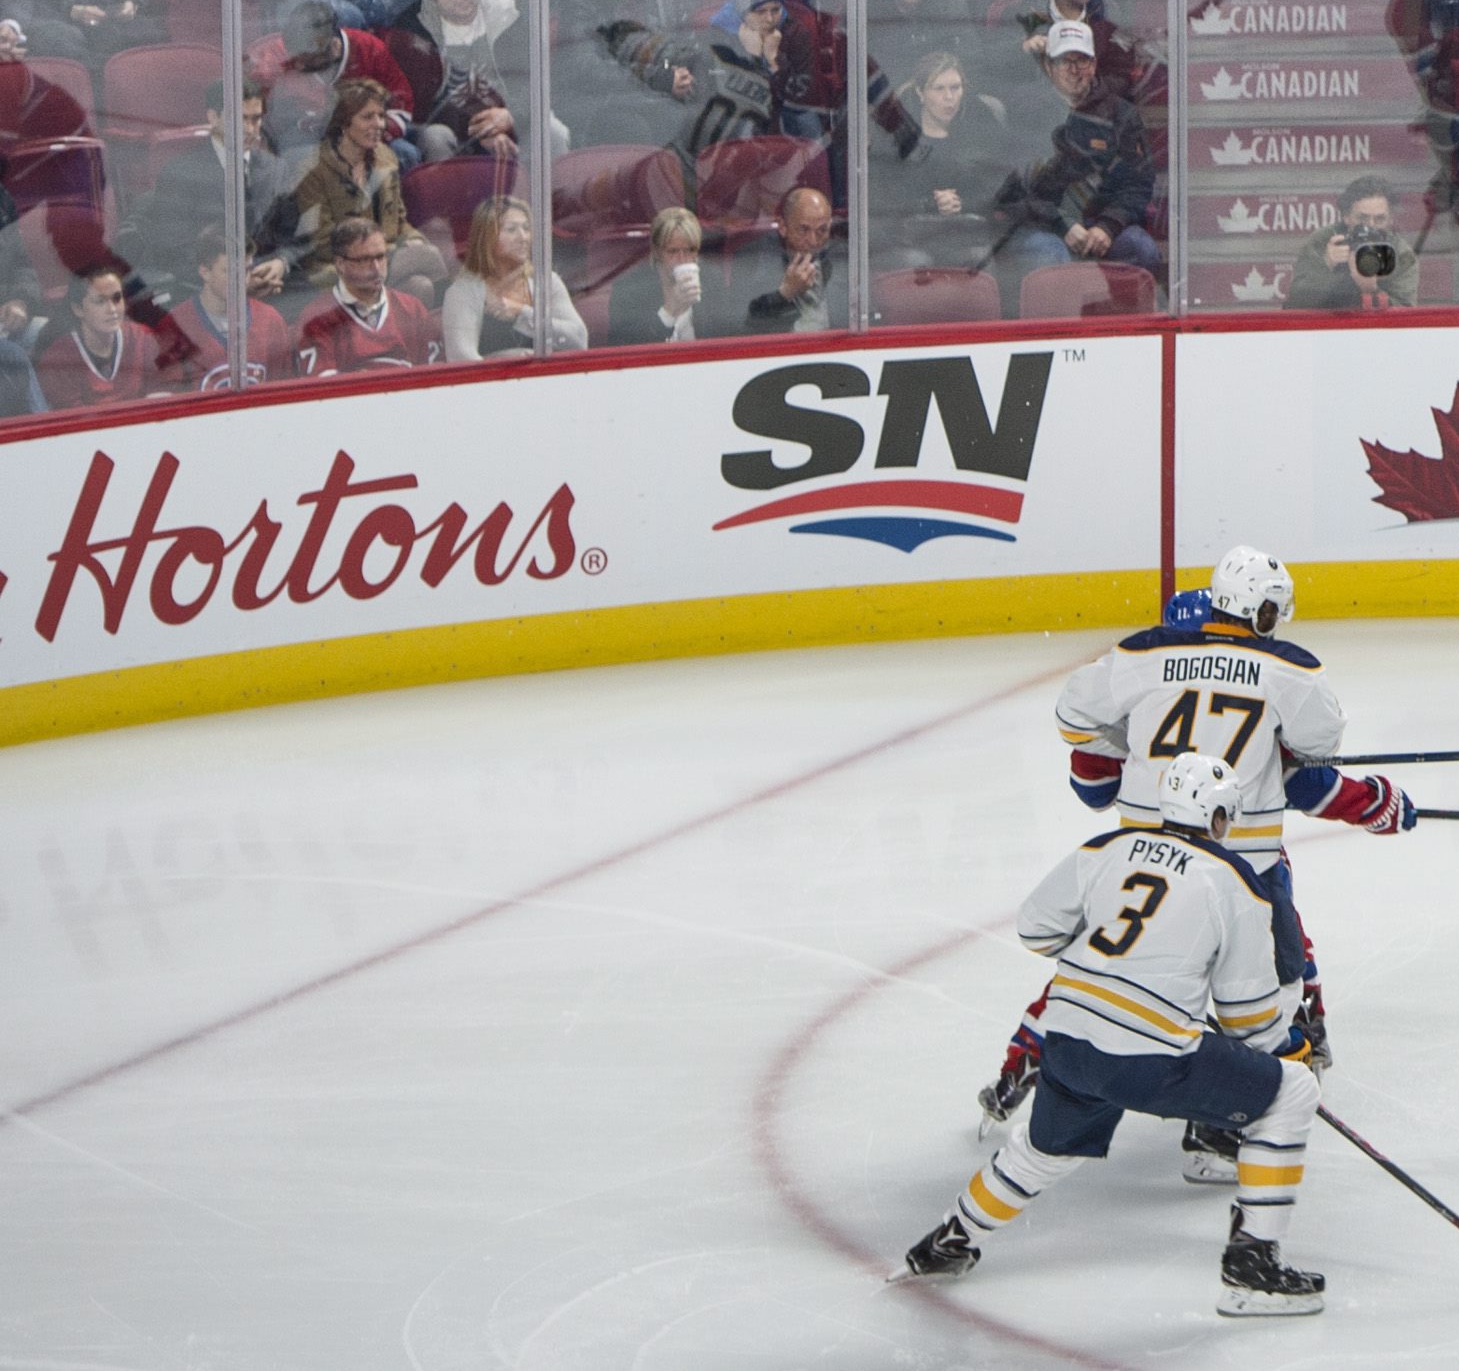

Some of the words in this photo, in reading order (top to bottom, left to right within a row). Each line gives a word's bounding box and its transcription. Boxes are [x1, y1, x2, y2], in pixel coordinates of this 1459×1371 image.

[1230, 5, 1347, 33] CANADIAN
[1241, 70, 1360, 98] CANADIAN
[1250, 135, 1371, 164] CANADIAN
[1258, 202, 1341, 231] CANAD
[721, 351, 1055, 490] SN
[35, 449, 576, 643] Hortons
[1218, 595, 1231, 611] 47
[1162, 655, 1261, 686] BOGOSIAN
[1149, 687, 1266, 769] 47
[1171, 777, 1181, 791] 3
[1128, 838, 1194, 876] PYSYK
[1088, 870, 1170, 959] 3
